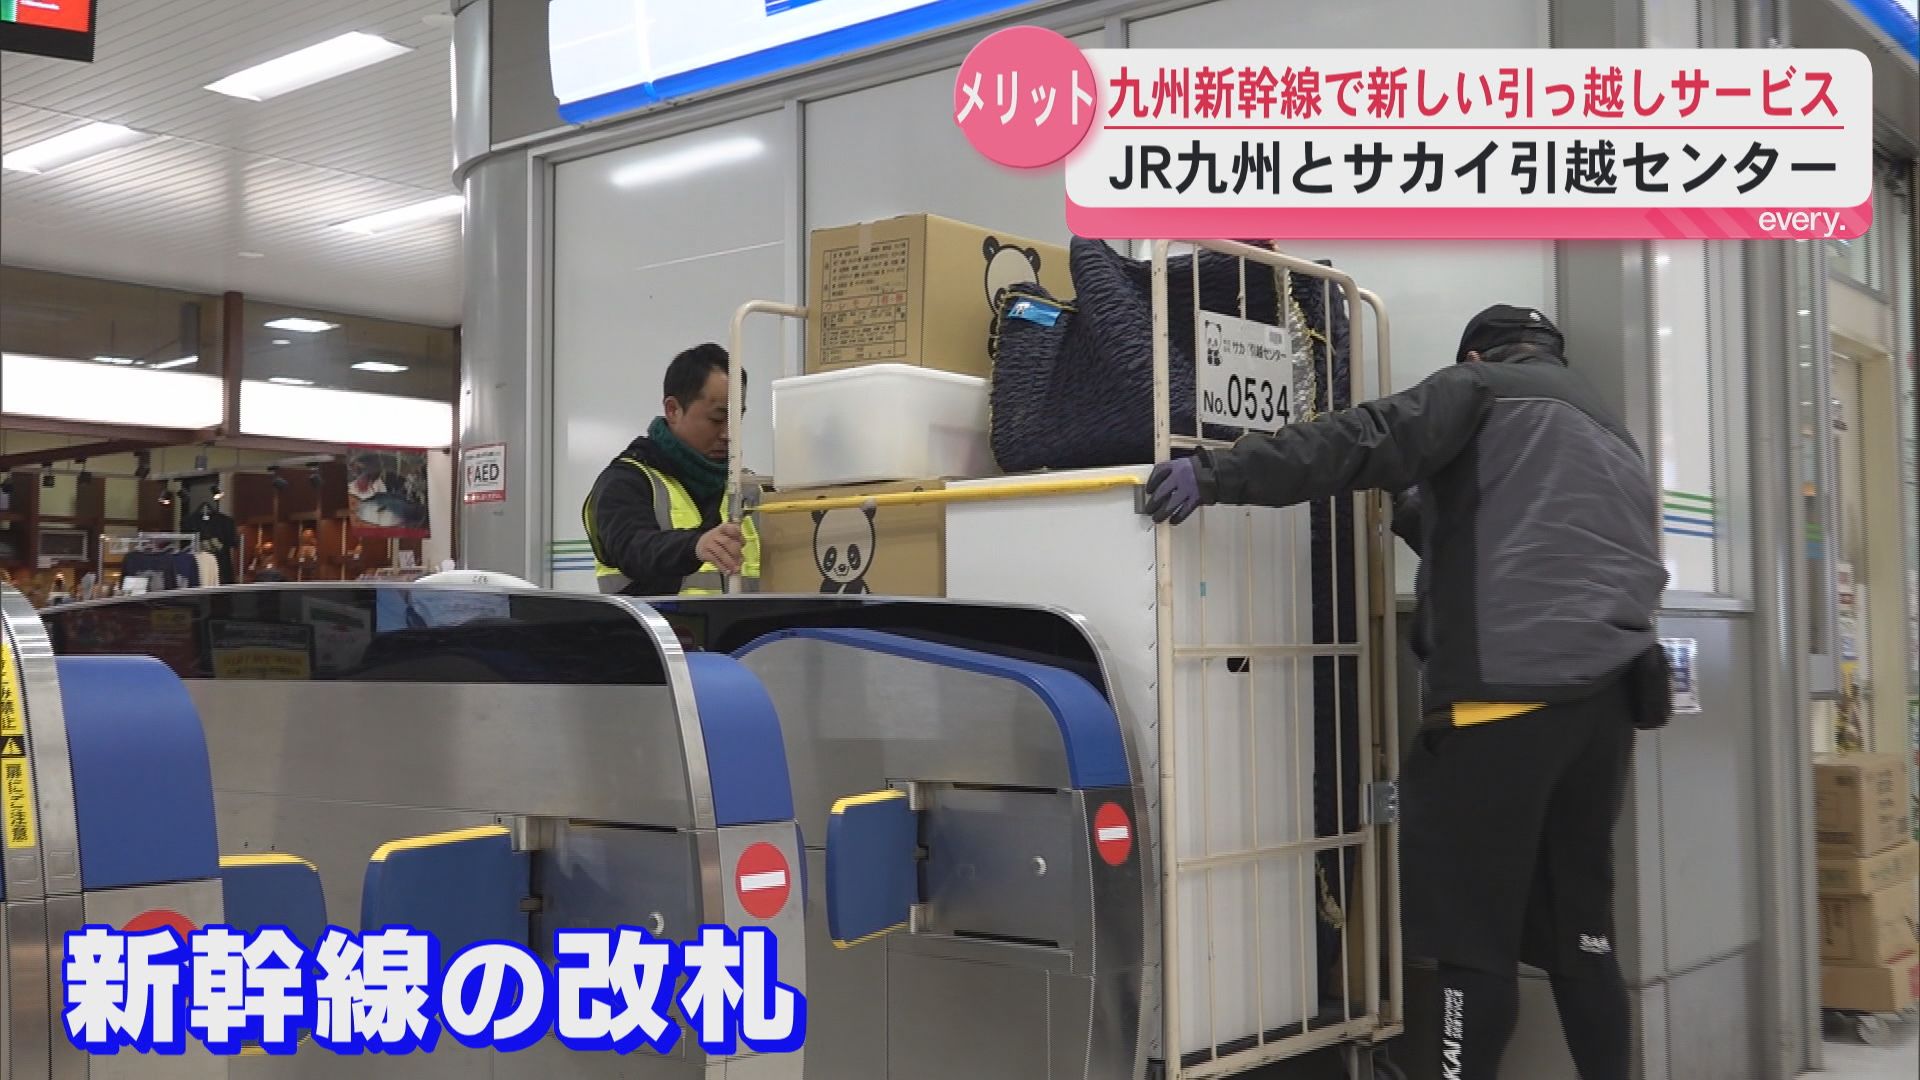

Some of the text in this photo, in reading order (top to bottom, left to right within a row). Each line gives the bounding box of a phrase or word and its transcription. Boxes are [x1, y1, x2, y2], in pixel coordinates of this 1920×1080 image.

[474, 463, 500, 483] AED
[6, 764, 28, 842] 扉にご注意
[1452, 989, 1464, 1040] SERVICE
